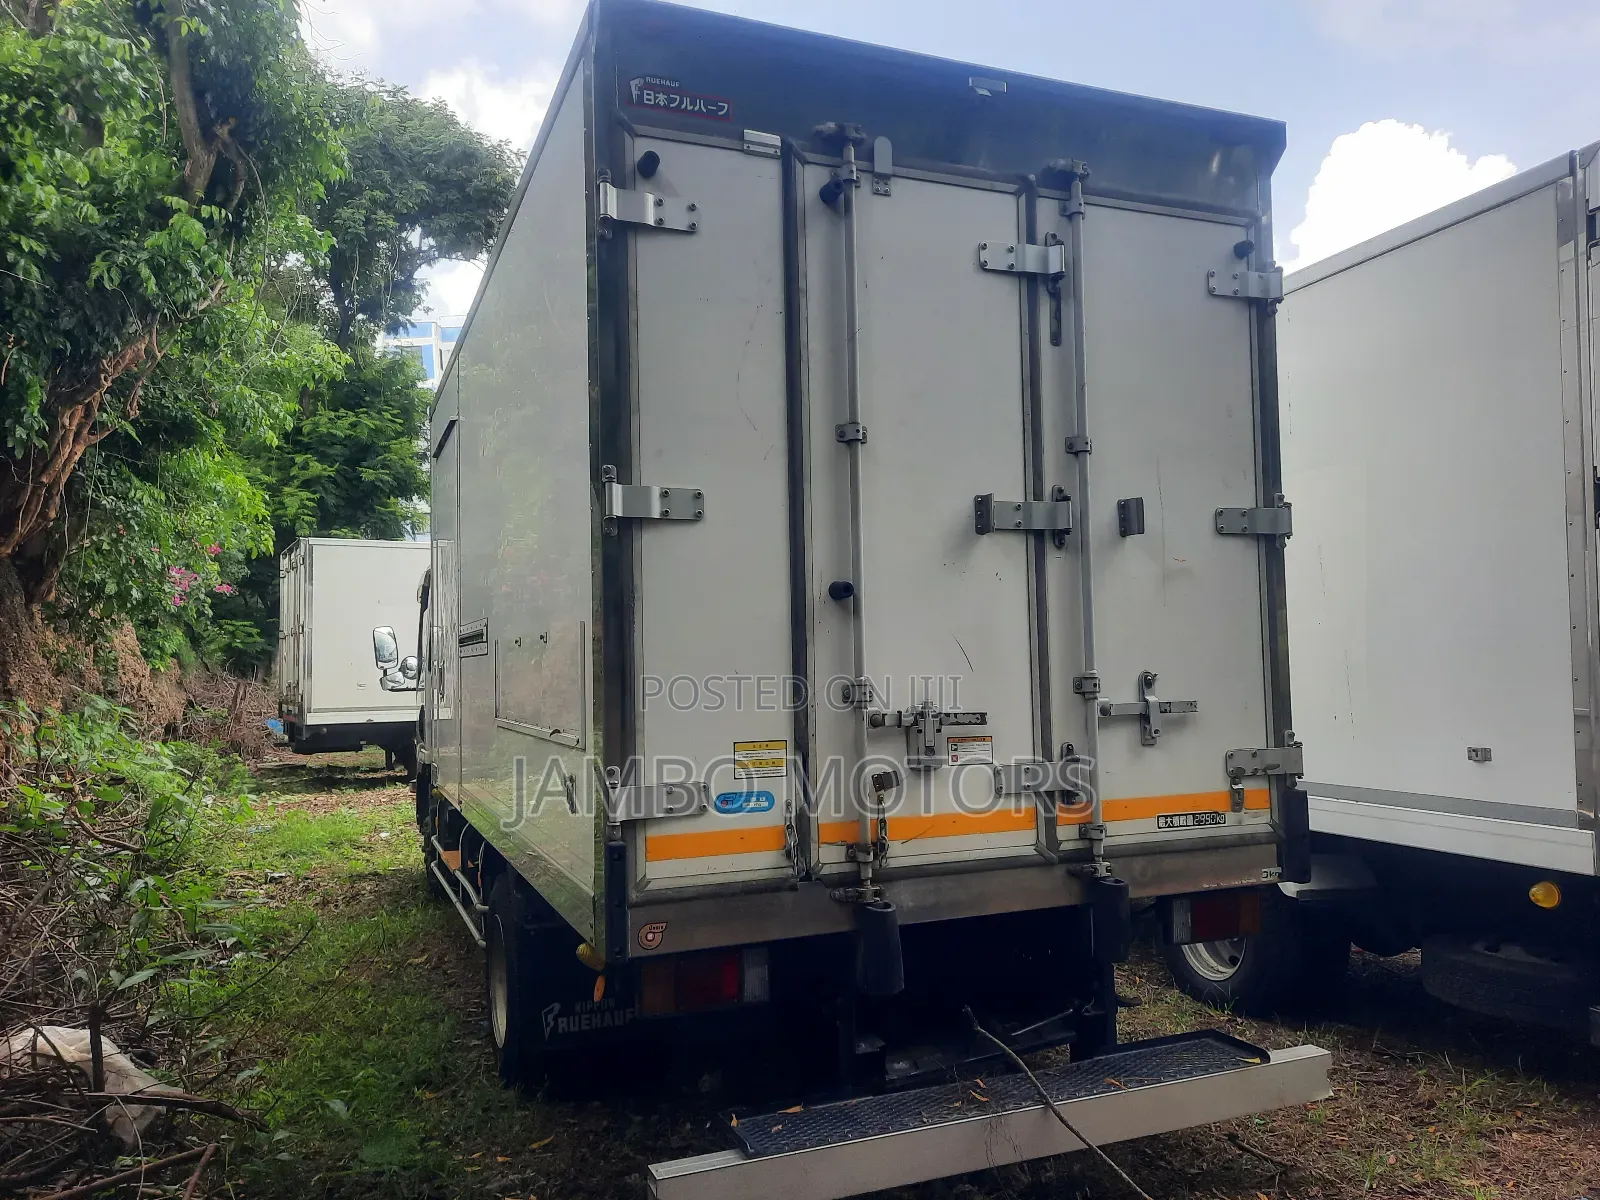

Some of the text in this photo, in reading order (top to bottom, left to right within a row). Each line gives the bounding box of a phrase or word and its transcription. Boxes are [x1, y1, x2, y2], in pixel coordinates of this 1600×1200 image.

[643, 90, 729, 116] 日本フルハーフ
